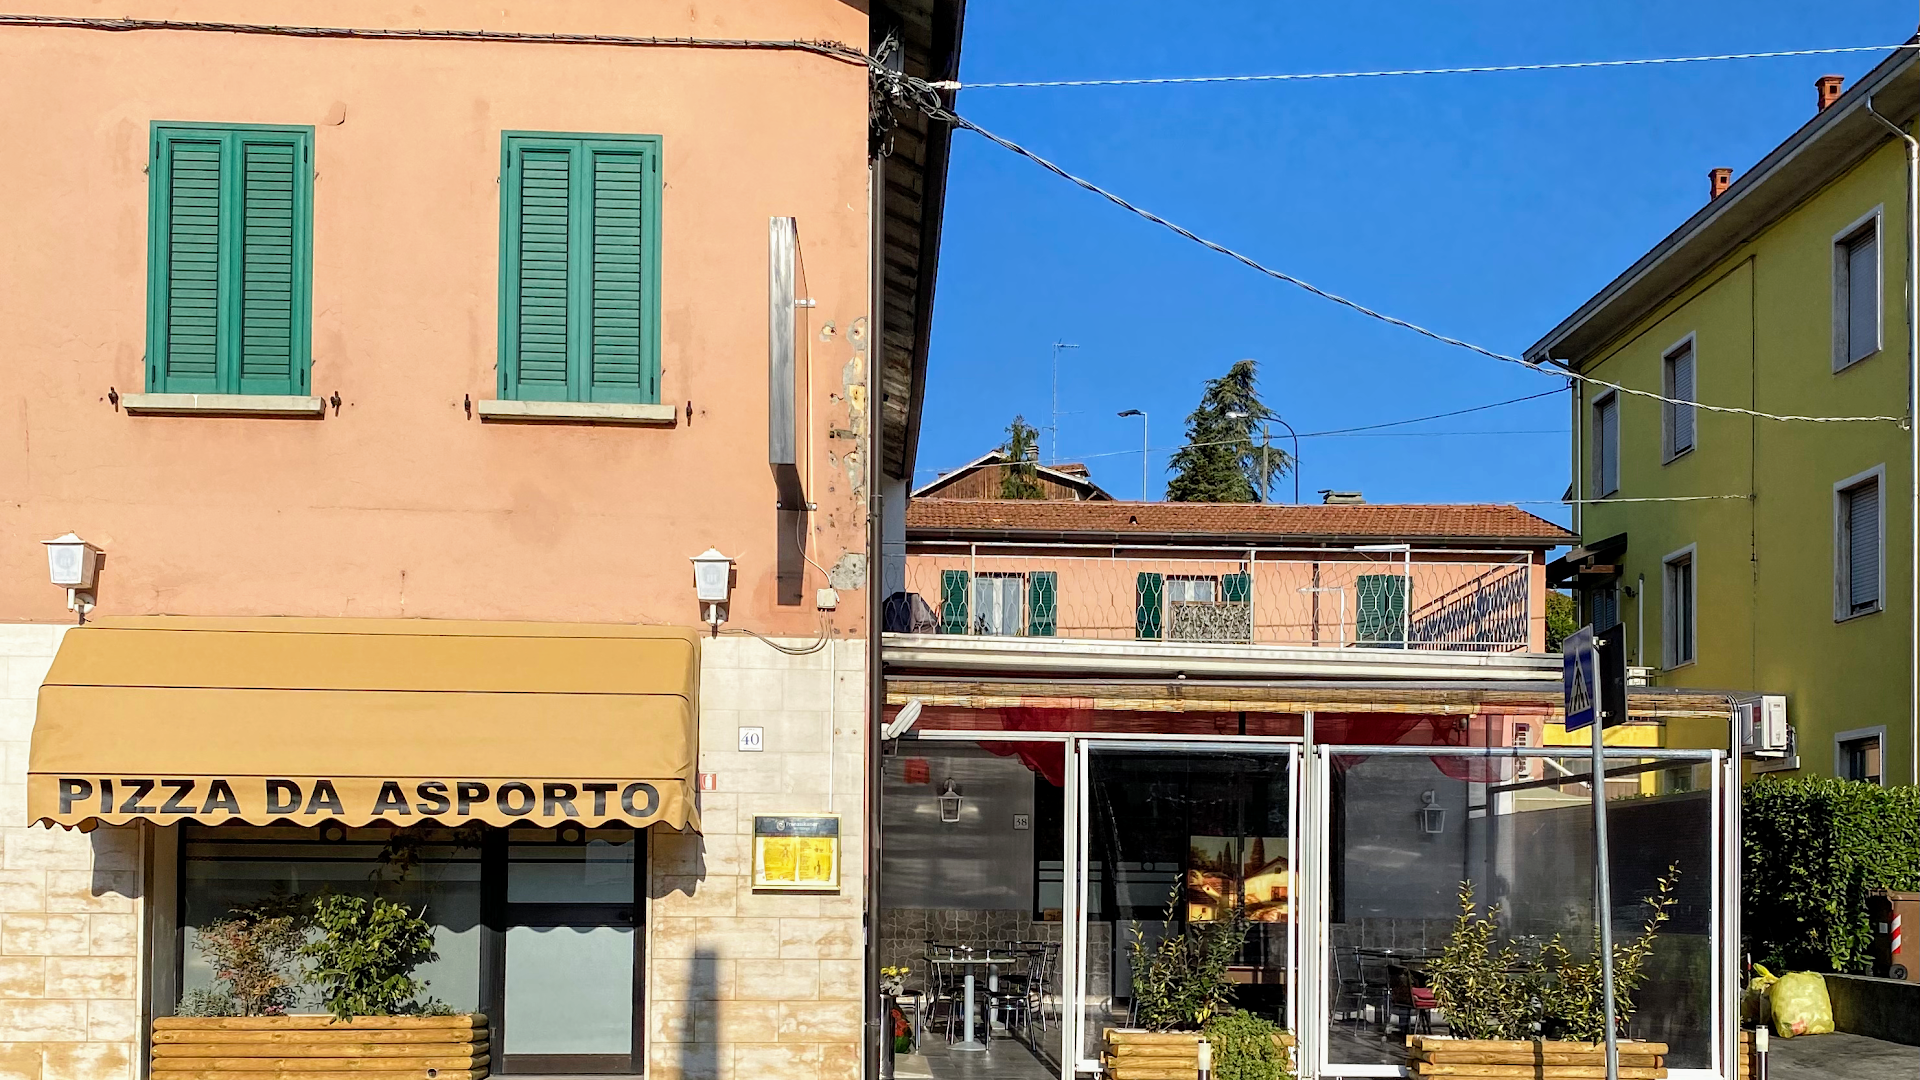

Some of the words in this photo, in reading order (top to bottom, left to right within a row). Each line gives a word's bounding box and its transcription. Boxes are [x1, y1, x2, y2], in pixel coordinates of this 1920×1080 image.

[741, 732, 760, 745] 40
[58, 778, 242, 815] PIZZA
[265, 779, 346, 816] DA
[370, 781, 660, 817] ASPORTO
[1015, 817, 1028, 827] 38
